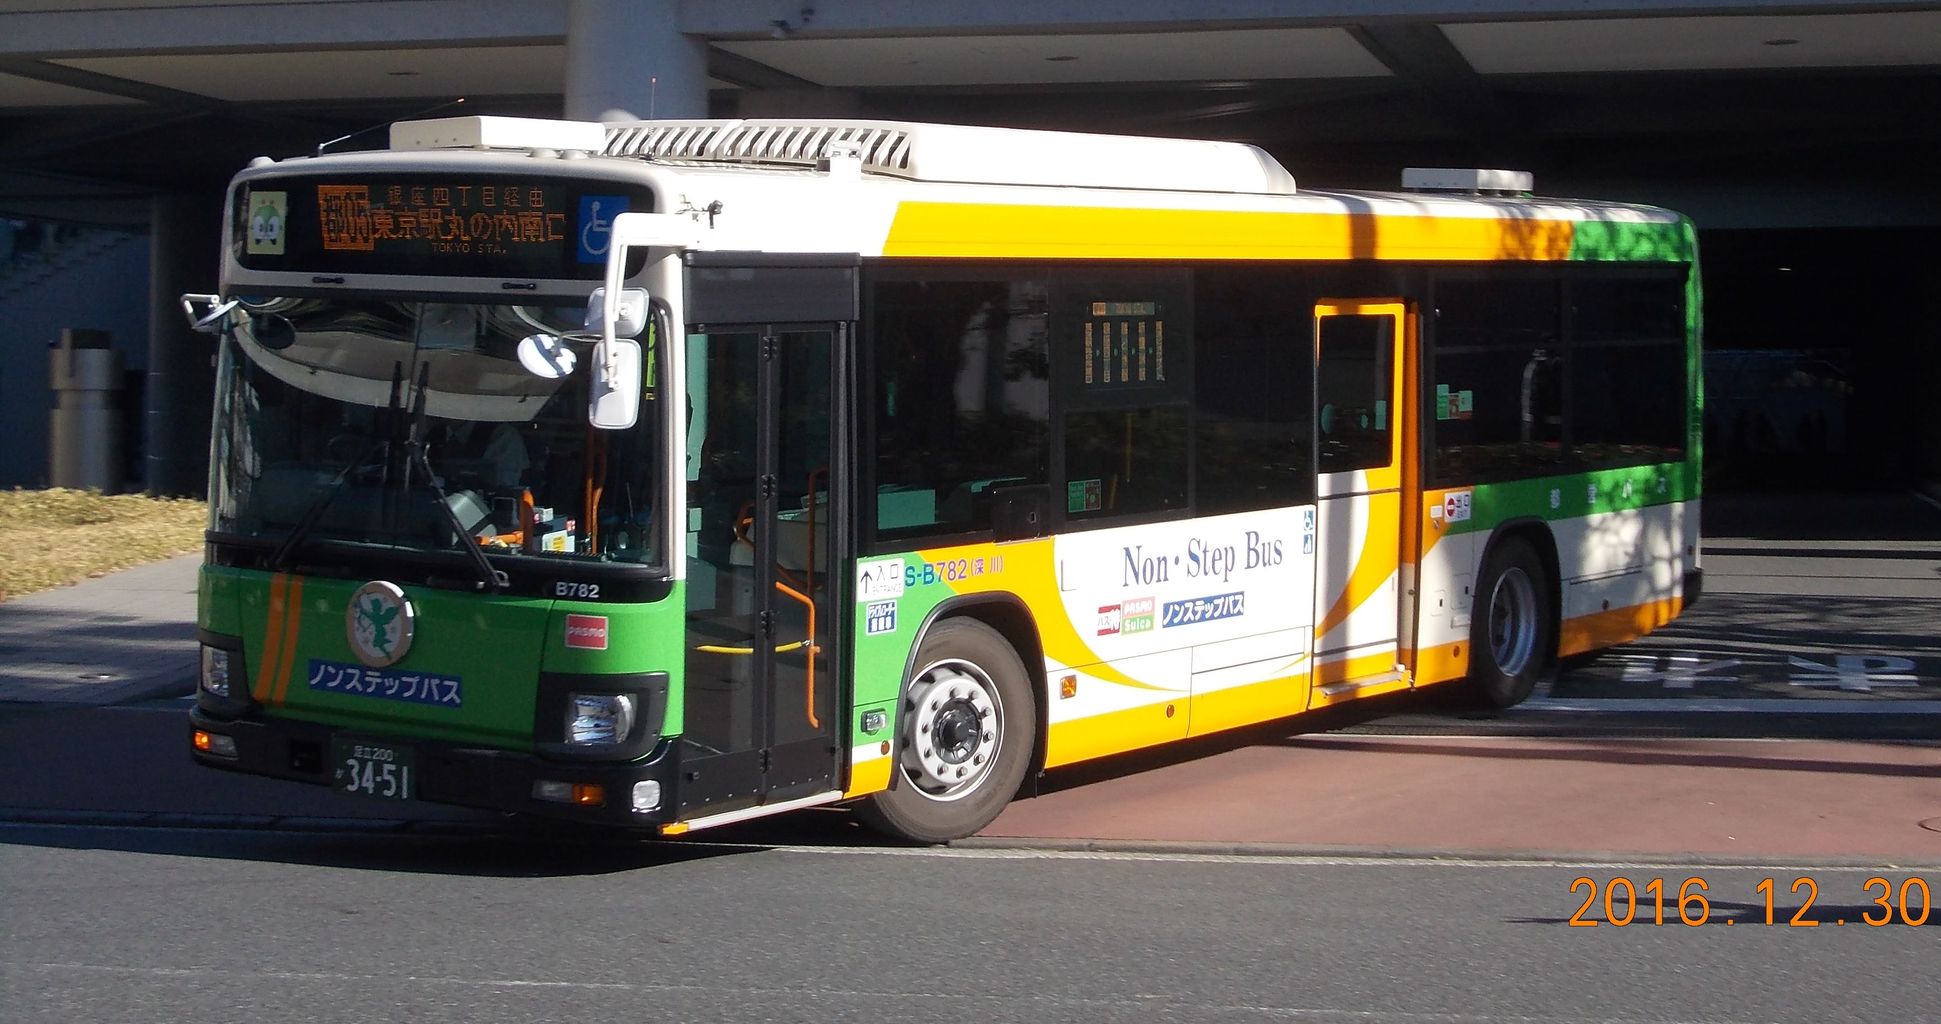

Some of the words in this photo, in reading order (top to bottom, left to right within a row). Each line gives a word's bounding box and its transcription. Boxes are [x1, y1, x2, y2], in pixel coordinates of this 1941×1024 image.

[431, 242, 471, 254] TOKYO
[1122, 545, 1169, 588] Non
[1186, 537, 1236, 583] Step
[1244, 530, 1283, 571] Bus
[904, 559, 967, 588] S-B782
[554, 581, 600, 599] B782
[1123, 599, 1153, 615] PASMO
[1162, 592, 1244, 627] ノンステップバス
[567, 626, 605, 638] PASMO
[1123, 616, 1152, 633] Suica
[309, 663, 462, 705] ノンステップバス
[346, 758, 409, 800] 34-51
